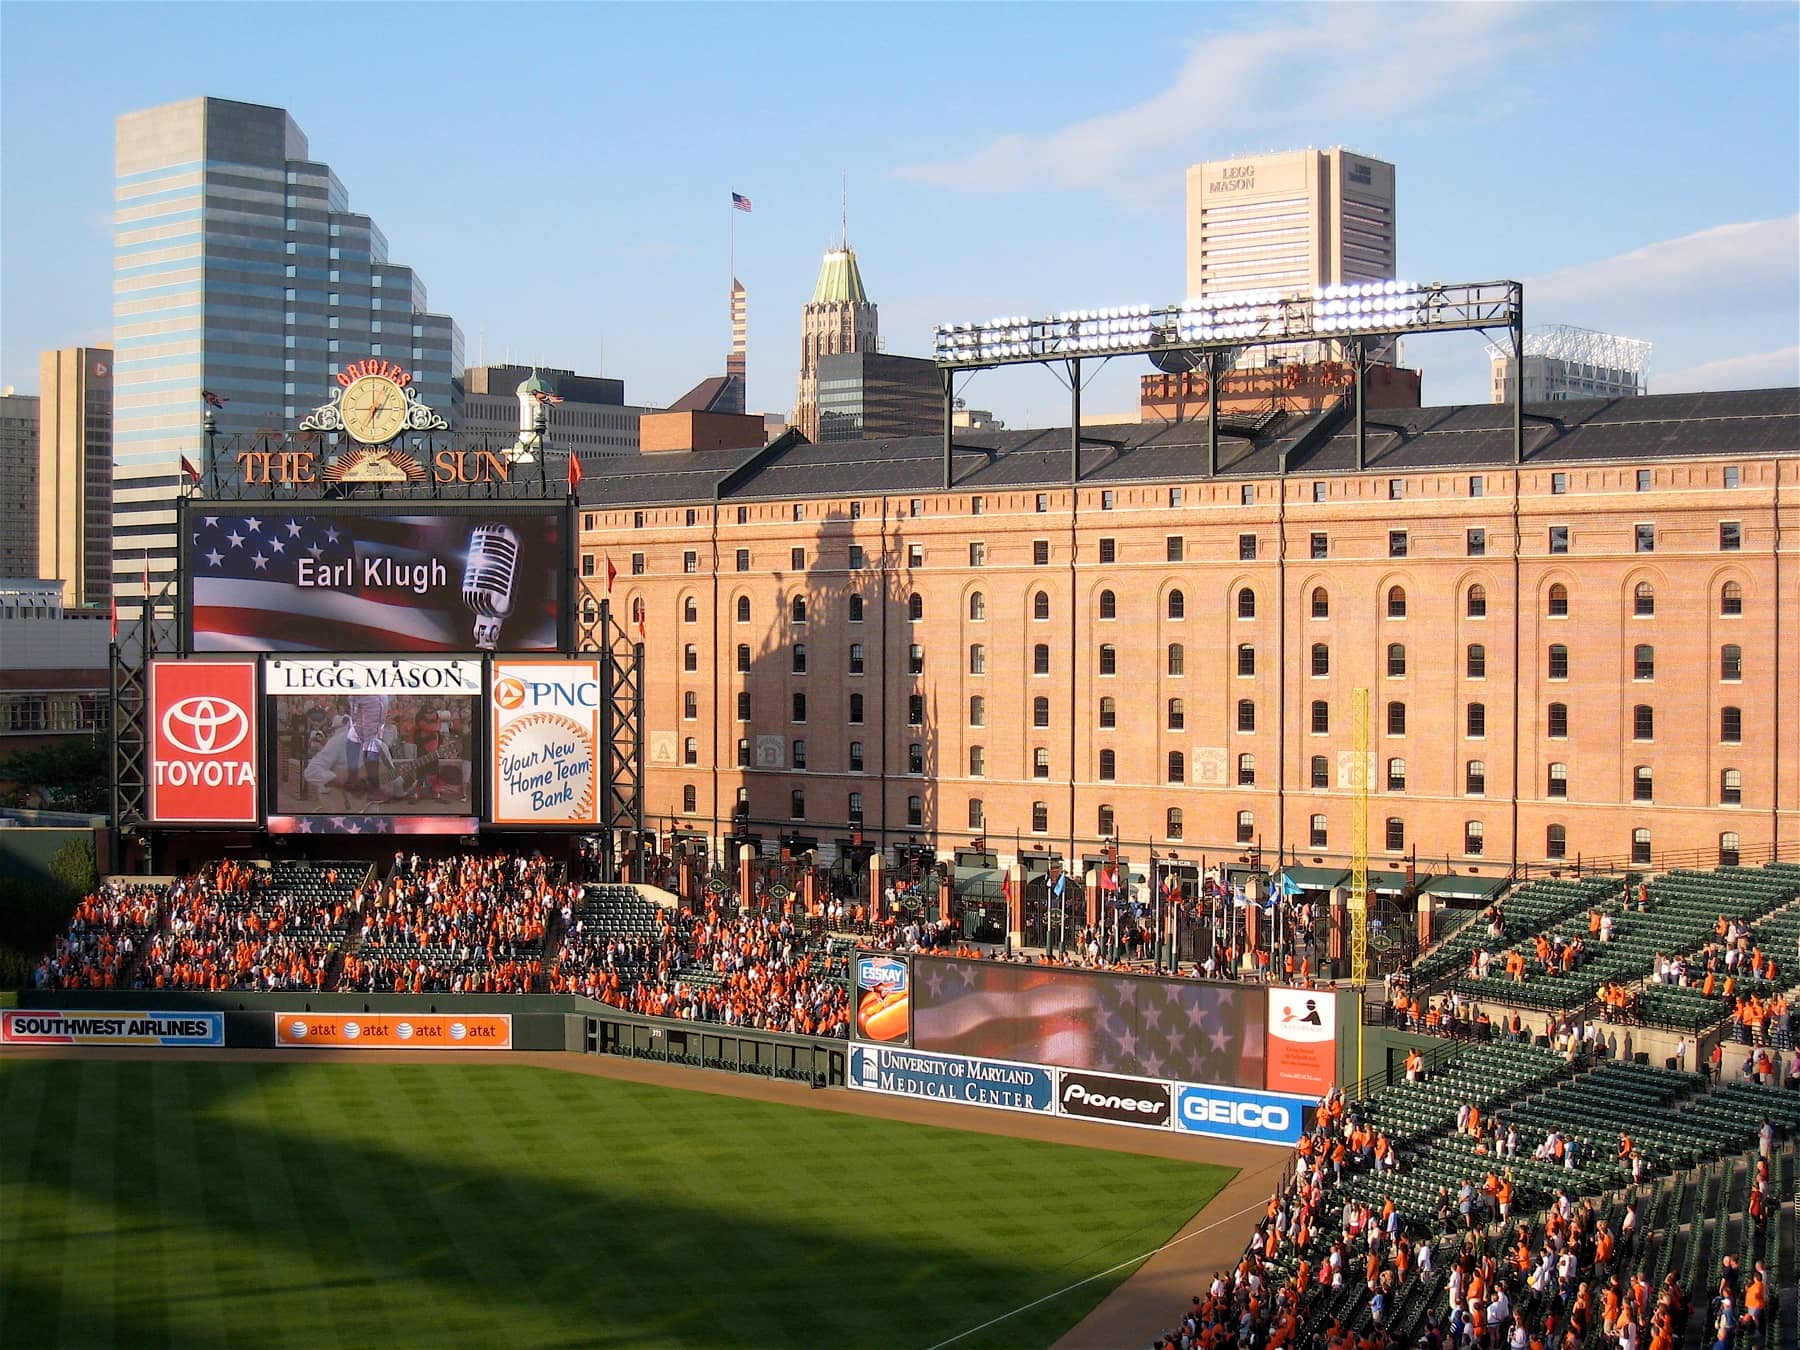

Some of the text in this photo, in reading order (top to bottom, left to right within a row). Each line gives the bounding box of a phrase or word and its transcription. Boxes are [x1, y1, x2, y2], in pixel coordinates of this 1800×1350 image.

[1222, 164, 1255, 179] LEGG
[1209, 178, 1255, 193] MASON
[336, 359, 412, 387] ORIOLES
[238, 450, 511, 483] THE SUN
[297, 558, 447, 593] Earl Klugh
[285, 667, 464, 688] LEGG MASON
[528, 682, 598, 707] PNC
[153, 760, 257, 787] TOYOTA
[502, 742, 575, 781] Your New
[510, 759, 590, 795] Home Team
[531, 782, 574, 811] Bank
[862, 966, 902, 983] ESSKAY
[15, 1018, 208, 1036] SOUTHWEST AIRLINES
[310, 1024, 336, 1036] at&t
[363, 1025, 389, 1036] at&t
[416, 1025, 442, 1037] at&t
[469, 1025, 496, 1037] at&t
[880, 1050, 1034, 1085] UNIVERSITY OF MARYLAND
[880, 1071, 1034, 1109] MEDICAL CENTER
[1183, 1096, 1289, 1131] GEICO
